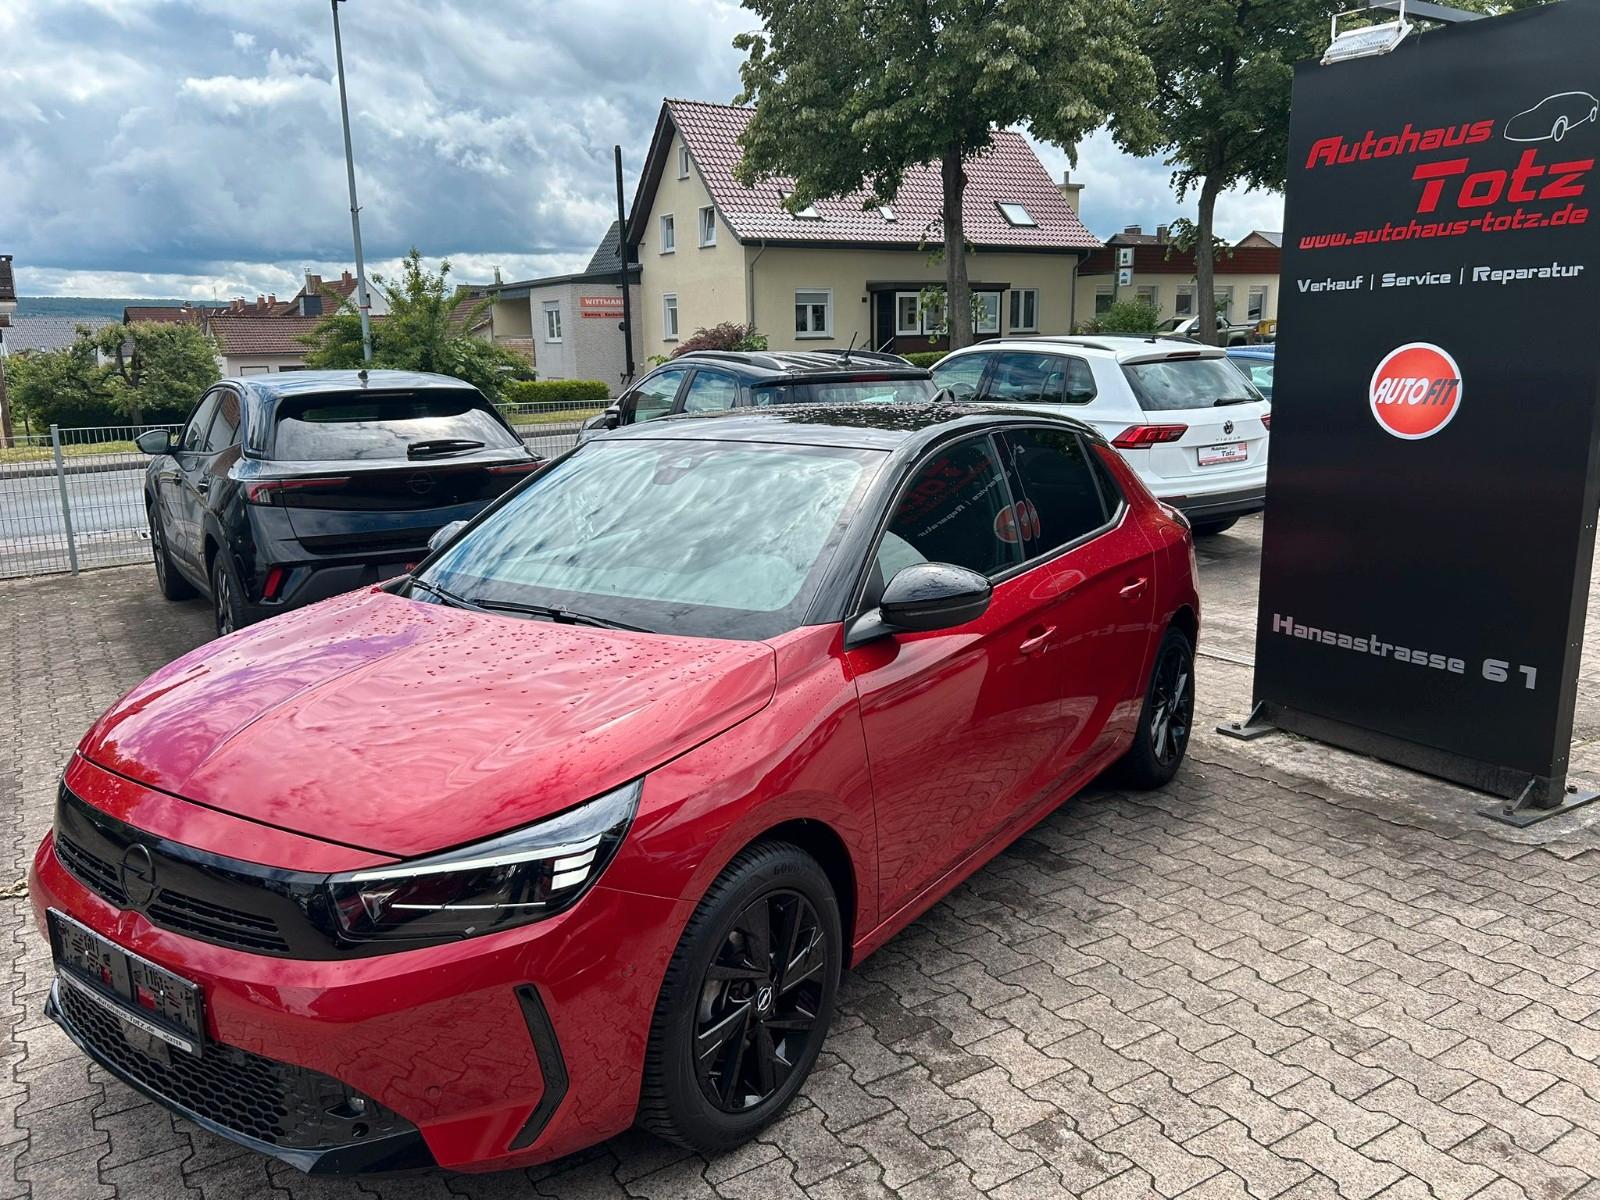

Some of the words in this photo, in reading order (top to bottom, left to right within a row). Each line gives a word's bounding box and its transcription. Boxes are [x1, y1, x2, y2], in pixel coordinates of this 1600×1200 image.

[1305, 119, 1495, 169] Autohaus
[1412, 149, 1595, 213] Totz
[1299, 203, 1589, 250] www.autohaus-totz.de
[1297, 275, 1363, 293] Verkauf
[1381, 271, 1452, 288] Service
[1472, 261, 1584, 285] Reparatur
[1374, 377, 1461, 406] AUTOFIT
[1272, 613, 1465, 674] Hansastrasse
[1481, 658, 1538, 690] 61
